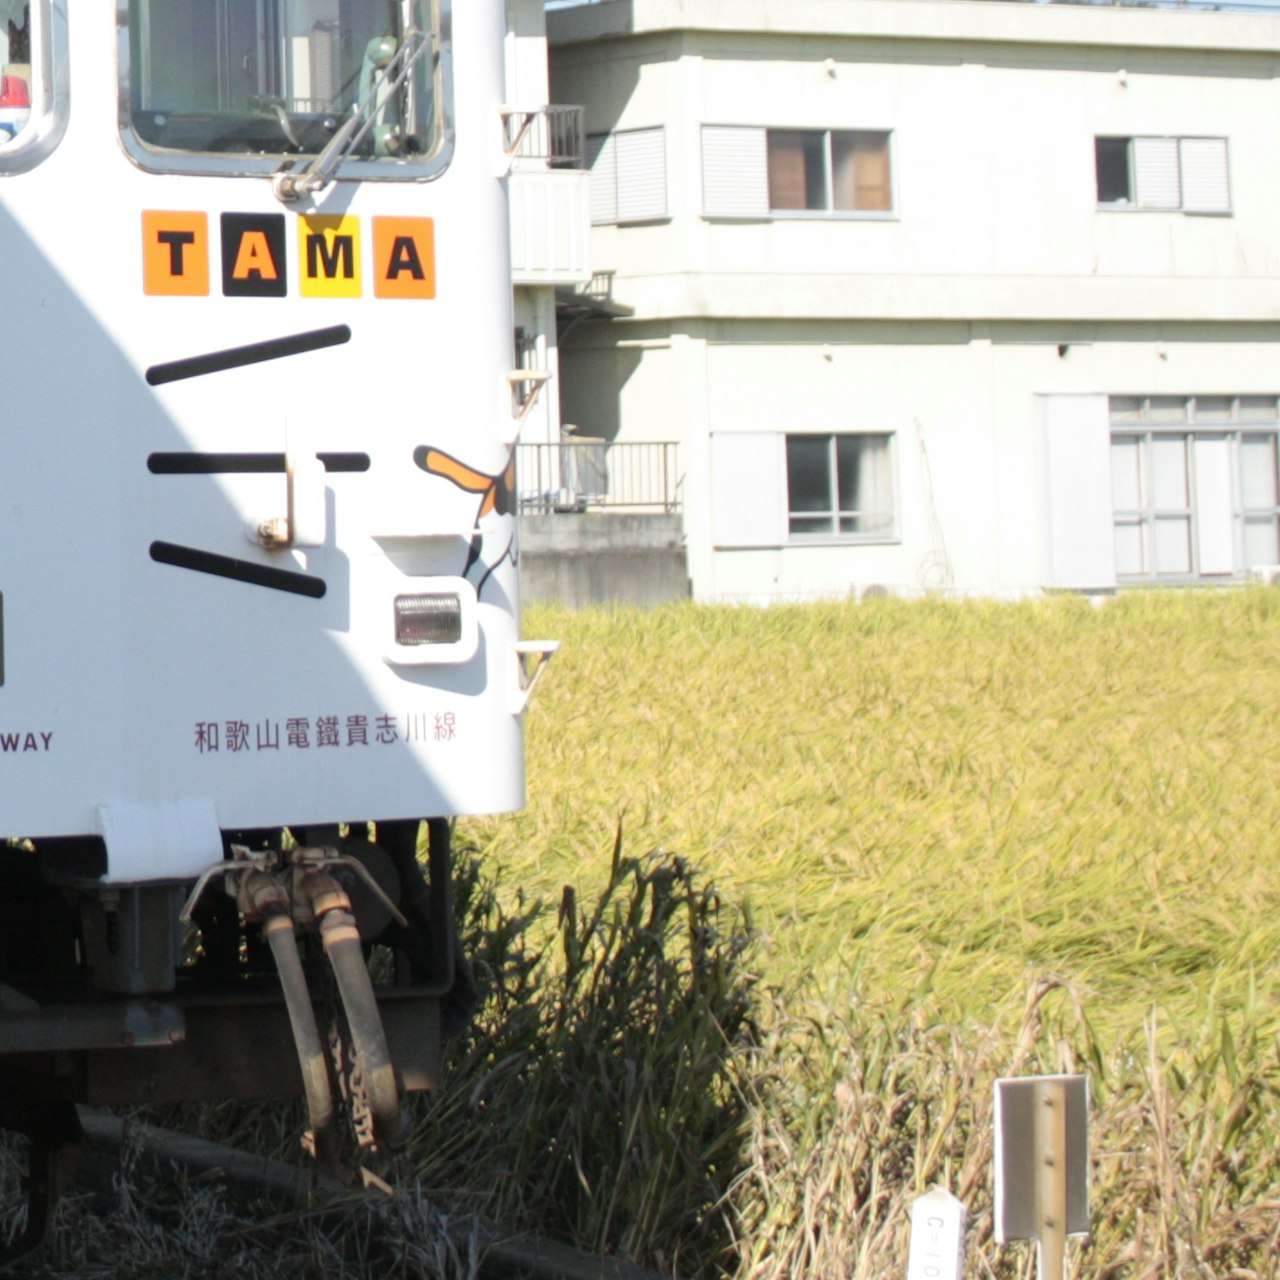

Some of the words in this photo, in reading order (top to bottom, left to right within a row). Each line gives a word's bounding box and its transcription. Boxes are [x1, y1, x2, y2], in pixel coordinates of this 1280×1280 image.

[156, 230, 427, 281] TAMA
[193, 710, 457, 755] 和歌山電鐵貴志川線
